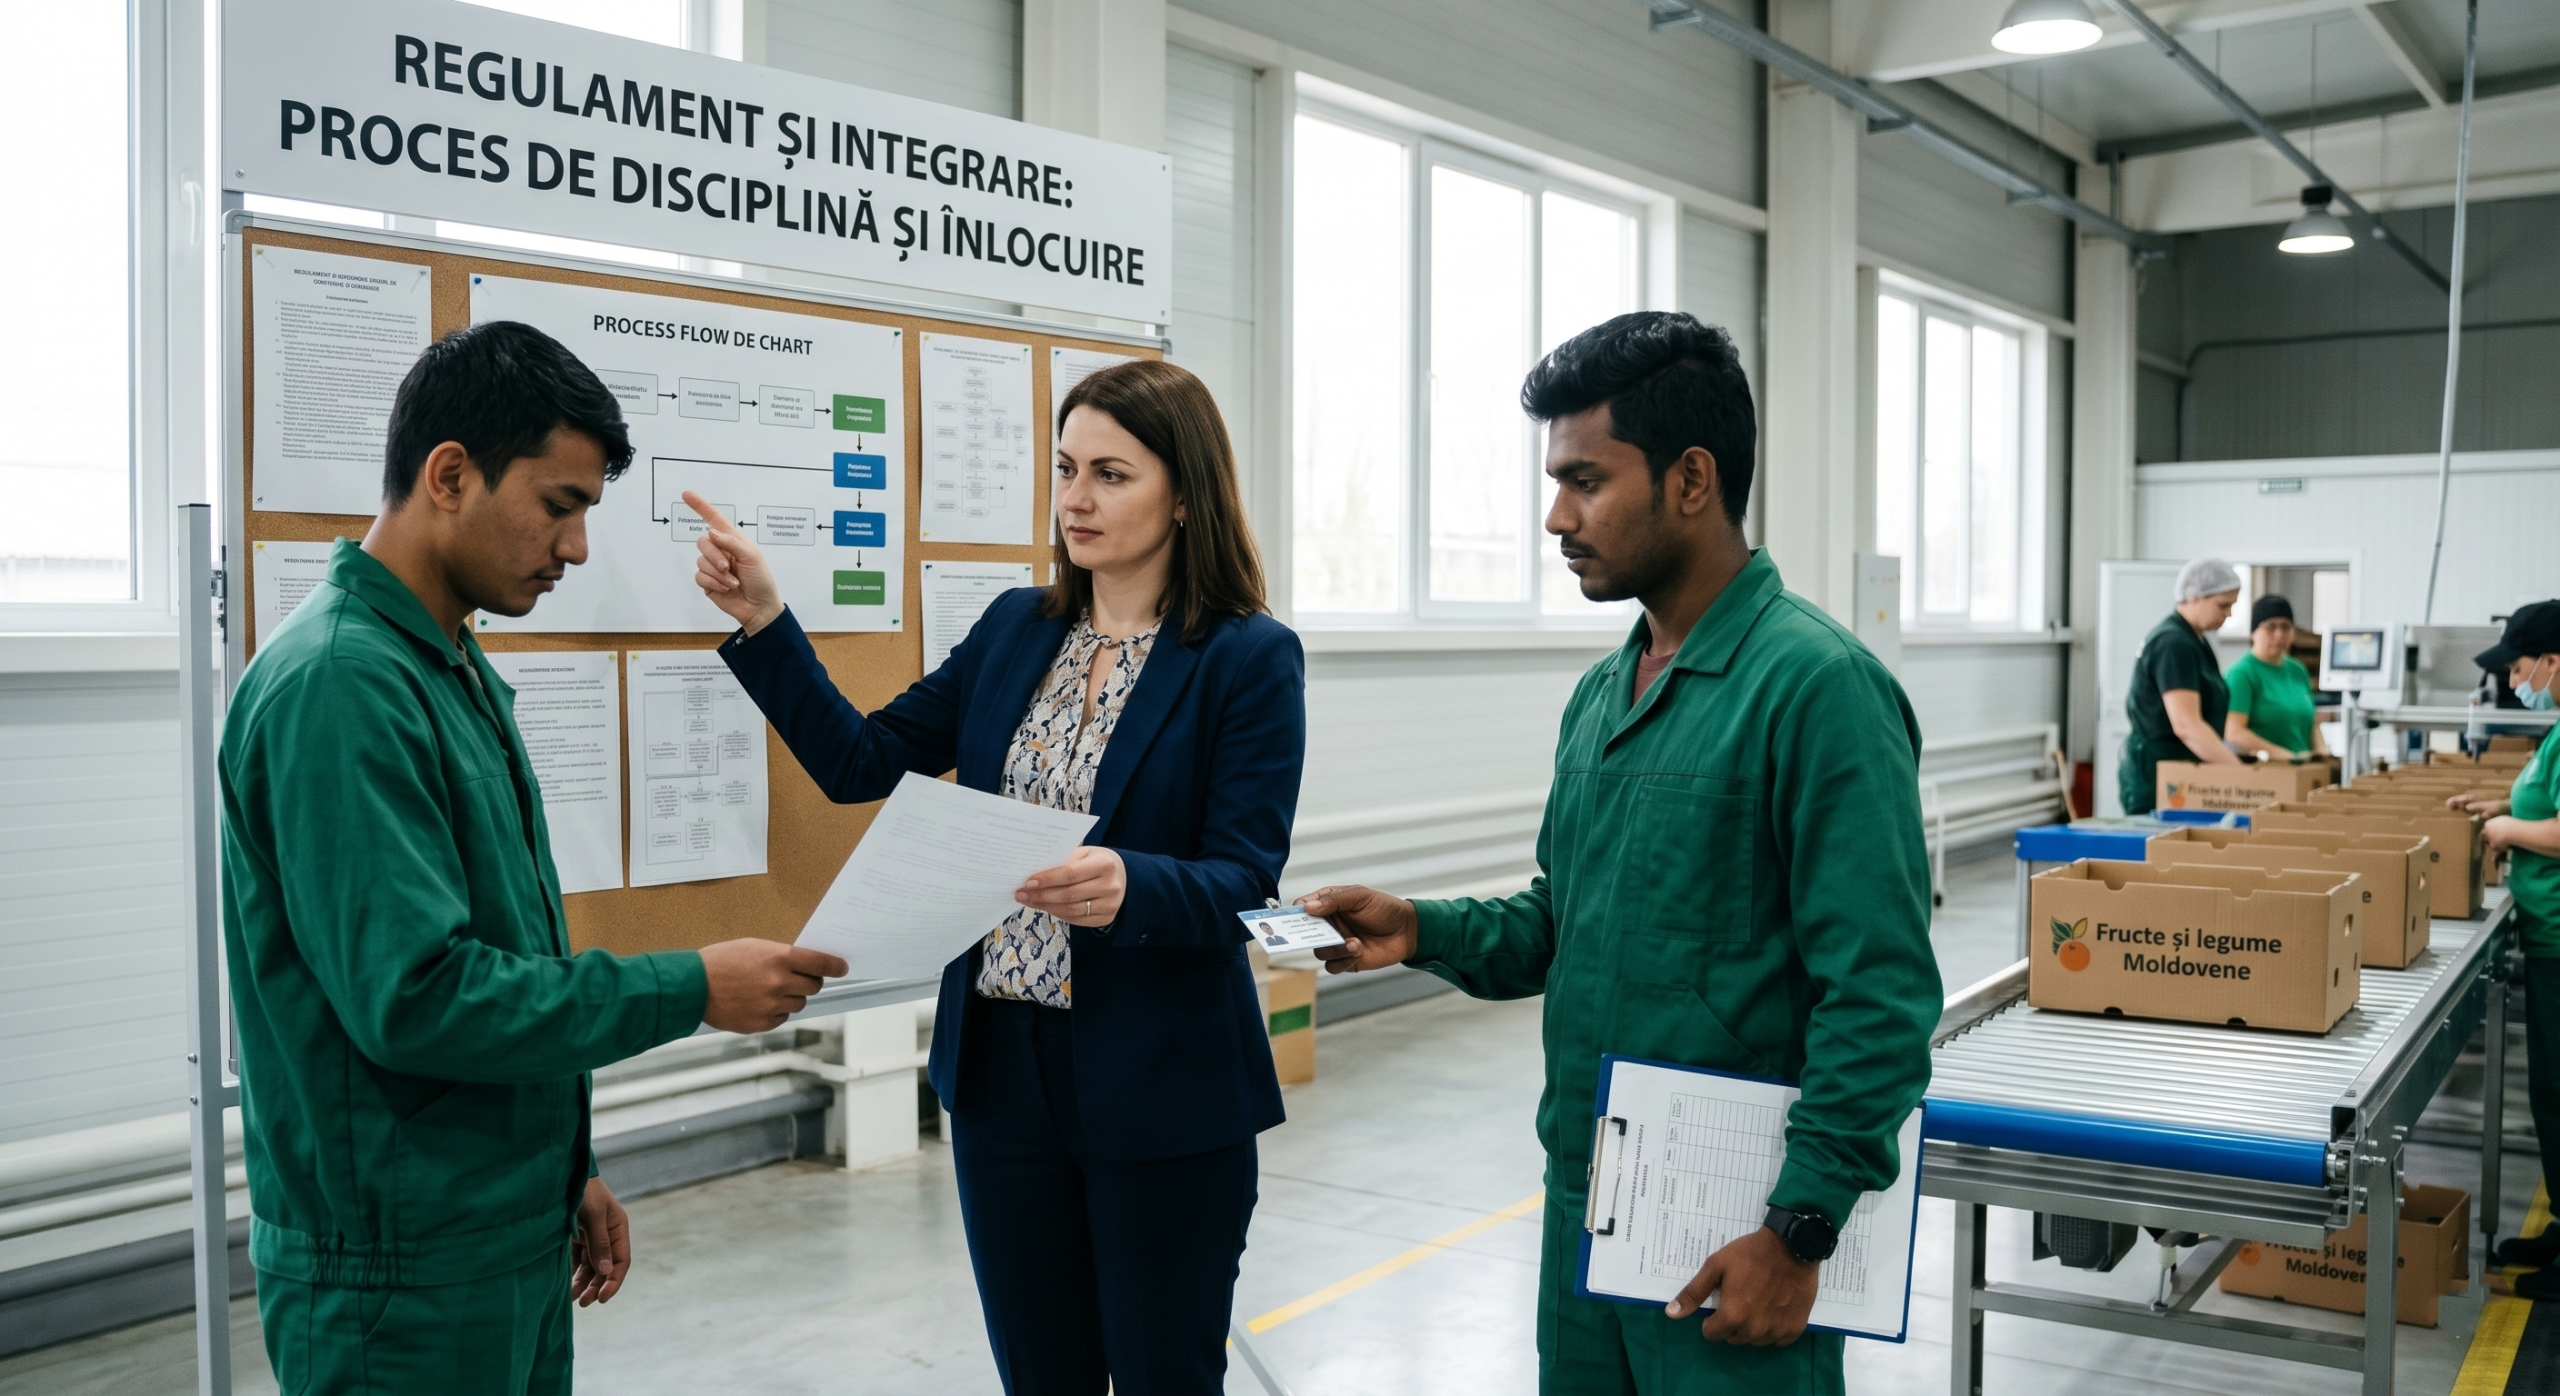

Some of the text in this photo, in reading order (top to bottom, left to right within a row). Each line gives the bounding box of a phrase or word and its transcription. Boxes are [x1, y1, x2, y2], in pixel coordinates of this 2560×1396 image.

[395, 33, 1074, 210] REGULAMENT ȘI INTEGRARE:
[280, 98, 1145, 287] PROCES DE DISCIPLINĂ ȘI ÎNLOCUIRE
[592, 314, 814, 356] PROCESS FLOW DE CHART
[2096, 922, 2283, 955] Fructe și legume
[2123, 952, 2251, 981] Moldovene
